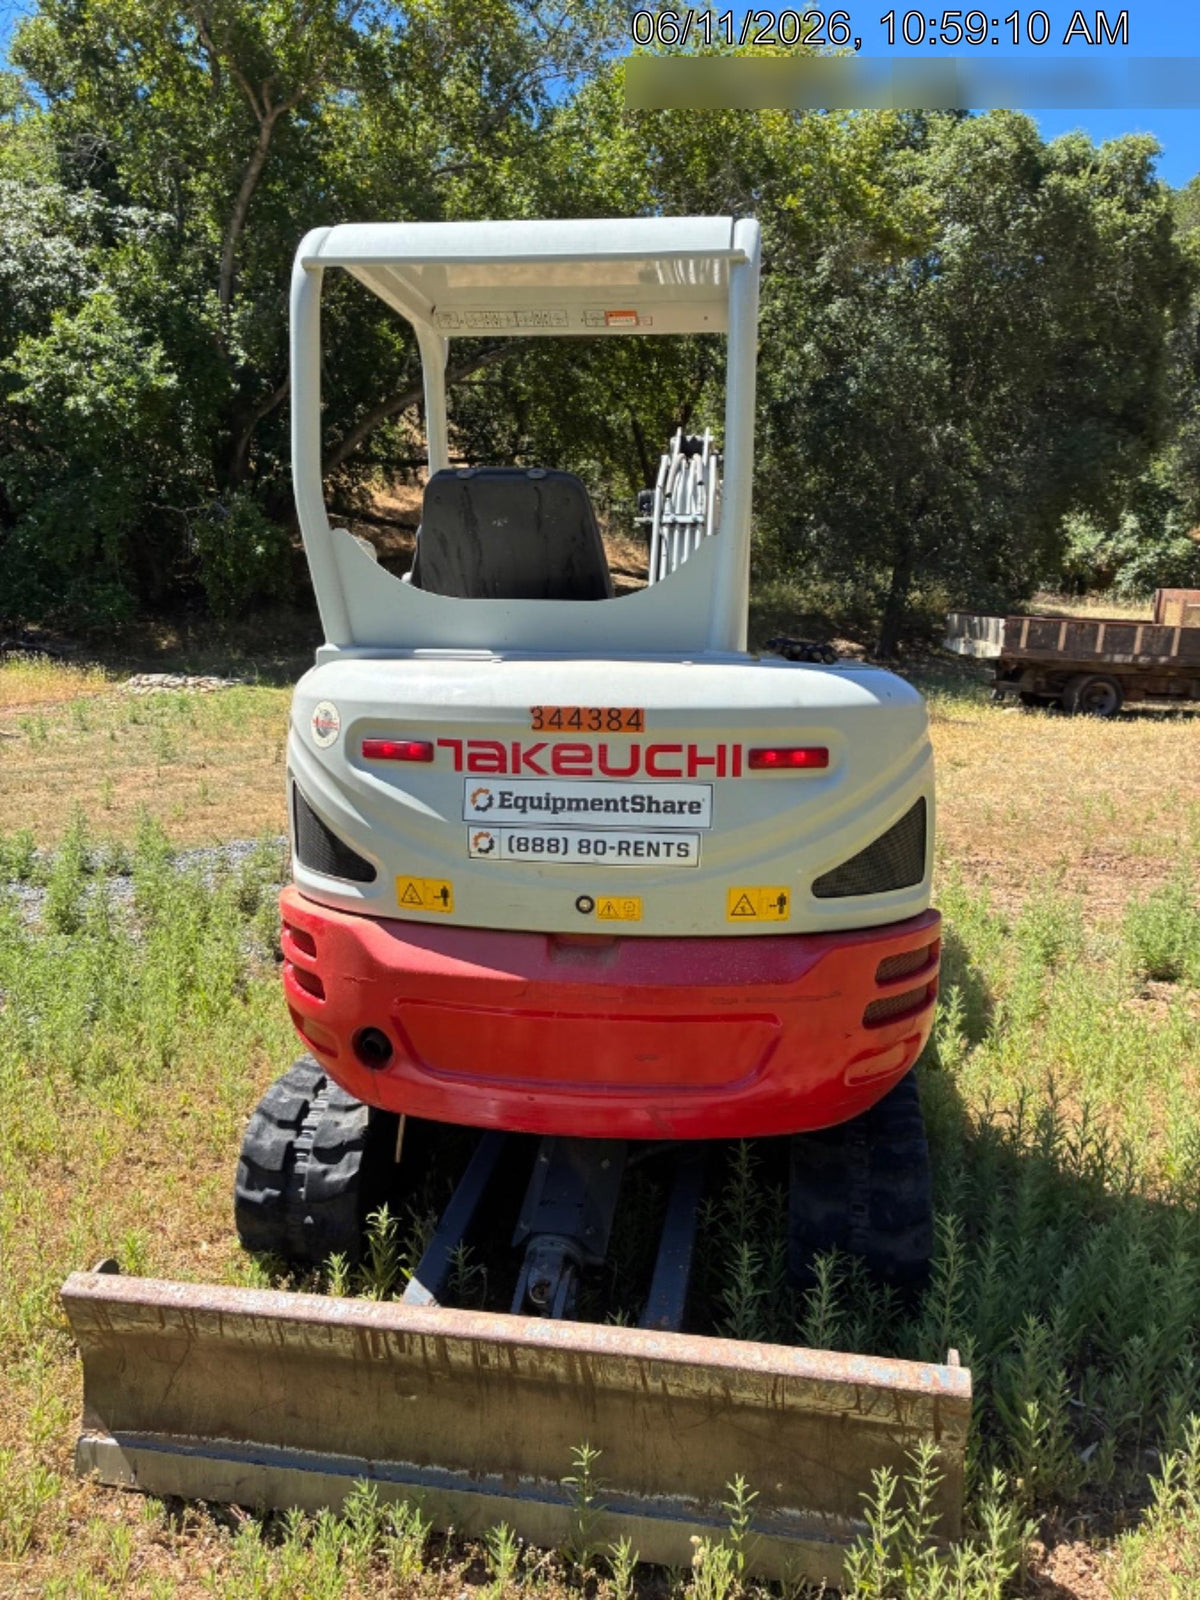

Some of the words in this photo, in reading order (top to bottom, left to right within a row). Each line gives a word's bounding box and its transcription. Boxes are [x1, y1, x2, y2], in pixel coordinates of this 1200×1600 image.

[531, 706, 644, 731] 344384
[498, 790, 703, 815] EquipmentShare
[507, 834, 569, 855] (888)
[577, 838, 691, 859] 80-RENTS
